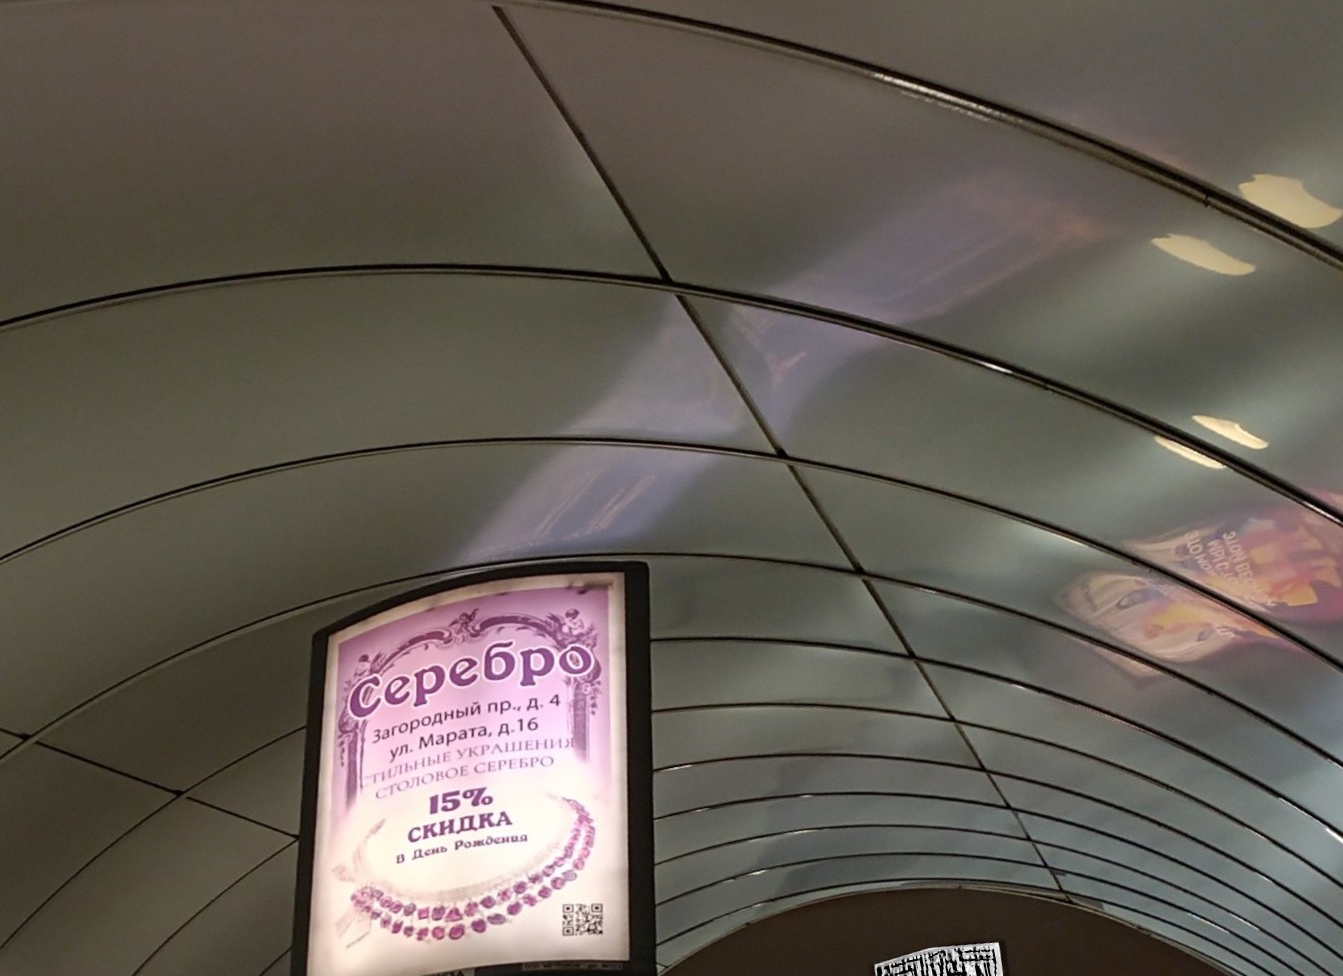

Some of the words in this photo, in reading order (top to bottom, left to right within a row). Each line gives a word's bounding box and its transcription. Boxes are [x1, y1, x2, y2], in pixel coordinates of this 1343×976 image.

[349, 641, 593, 719] Серебро
[372, 702, 481, 744] Загородный
[487, 700, 521, 715] пр.,
[526, 697, 545, 711] д.
[549, 694, 560, 707] 4
[390, 744, 414, 763] ул.
[418, 725, 493, 750] Марата,
[497, 717, 539, 737] д.16
[456, 738, 575, 760] УКРАШЕНИЯ
[375, 766, 468, 799] СТОЛОВОЕ
[474, 756, 555, 774] СЕРЕБРО
[429, 787, 494, 815] 15%
[408, 811, 513, 843] СКИДКА
[411, 846, 448, 860] День
[454, 834, 528, 850] Рождения
